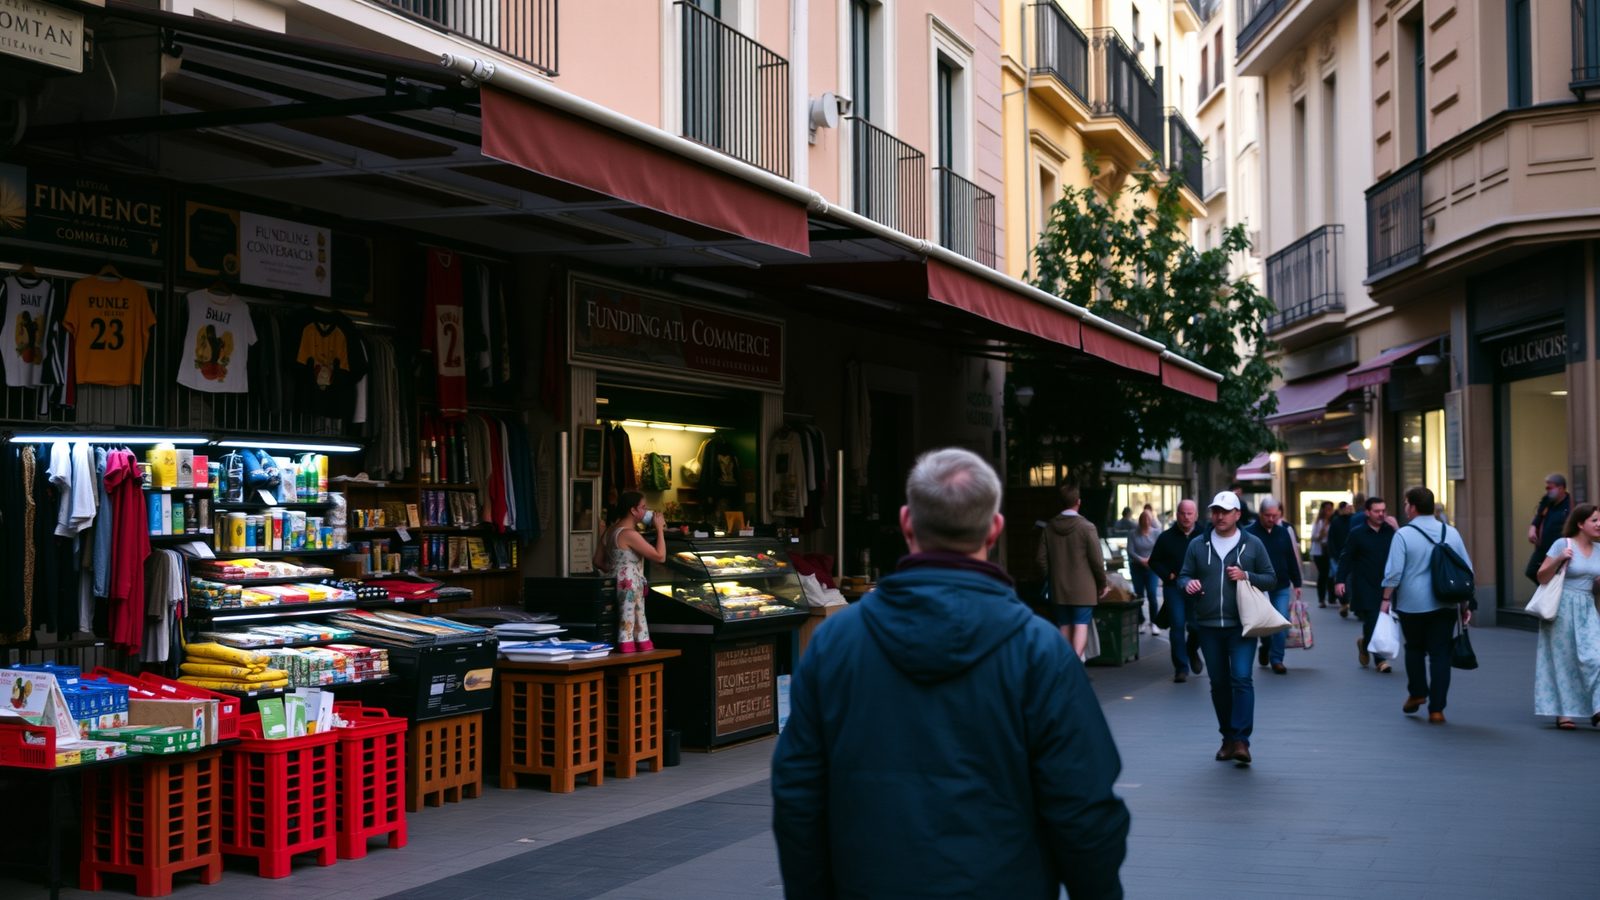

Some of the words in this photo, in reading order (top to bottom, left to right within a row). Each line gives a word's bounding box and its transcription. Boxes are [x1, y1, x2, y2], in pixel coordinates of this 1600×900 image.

[34, 183, 162, 229] FINMENCE
[90, 317, 124, 350] 23
[443, 323, 461, 368] 2
[586, 300, 660, 339] FUNDING
[691, 319, 771, 357] COMMERCE
